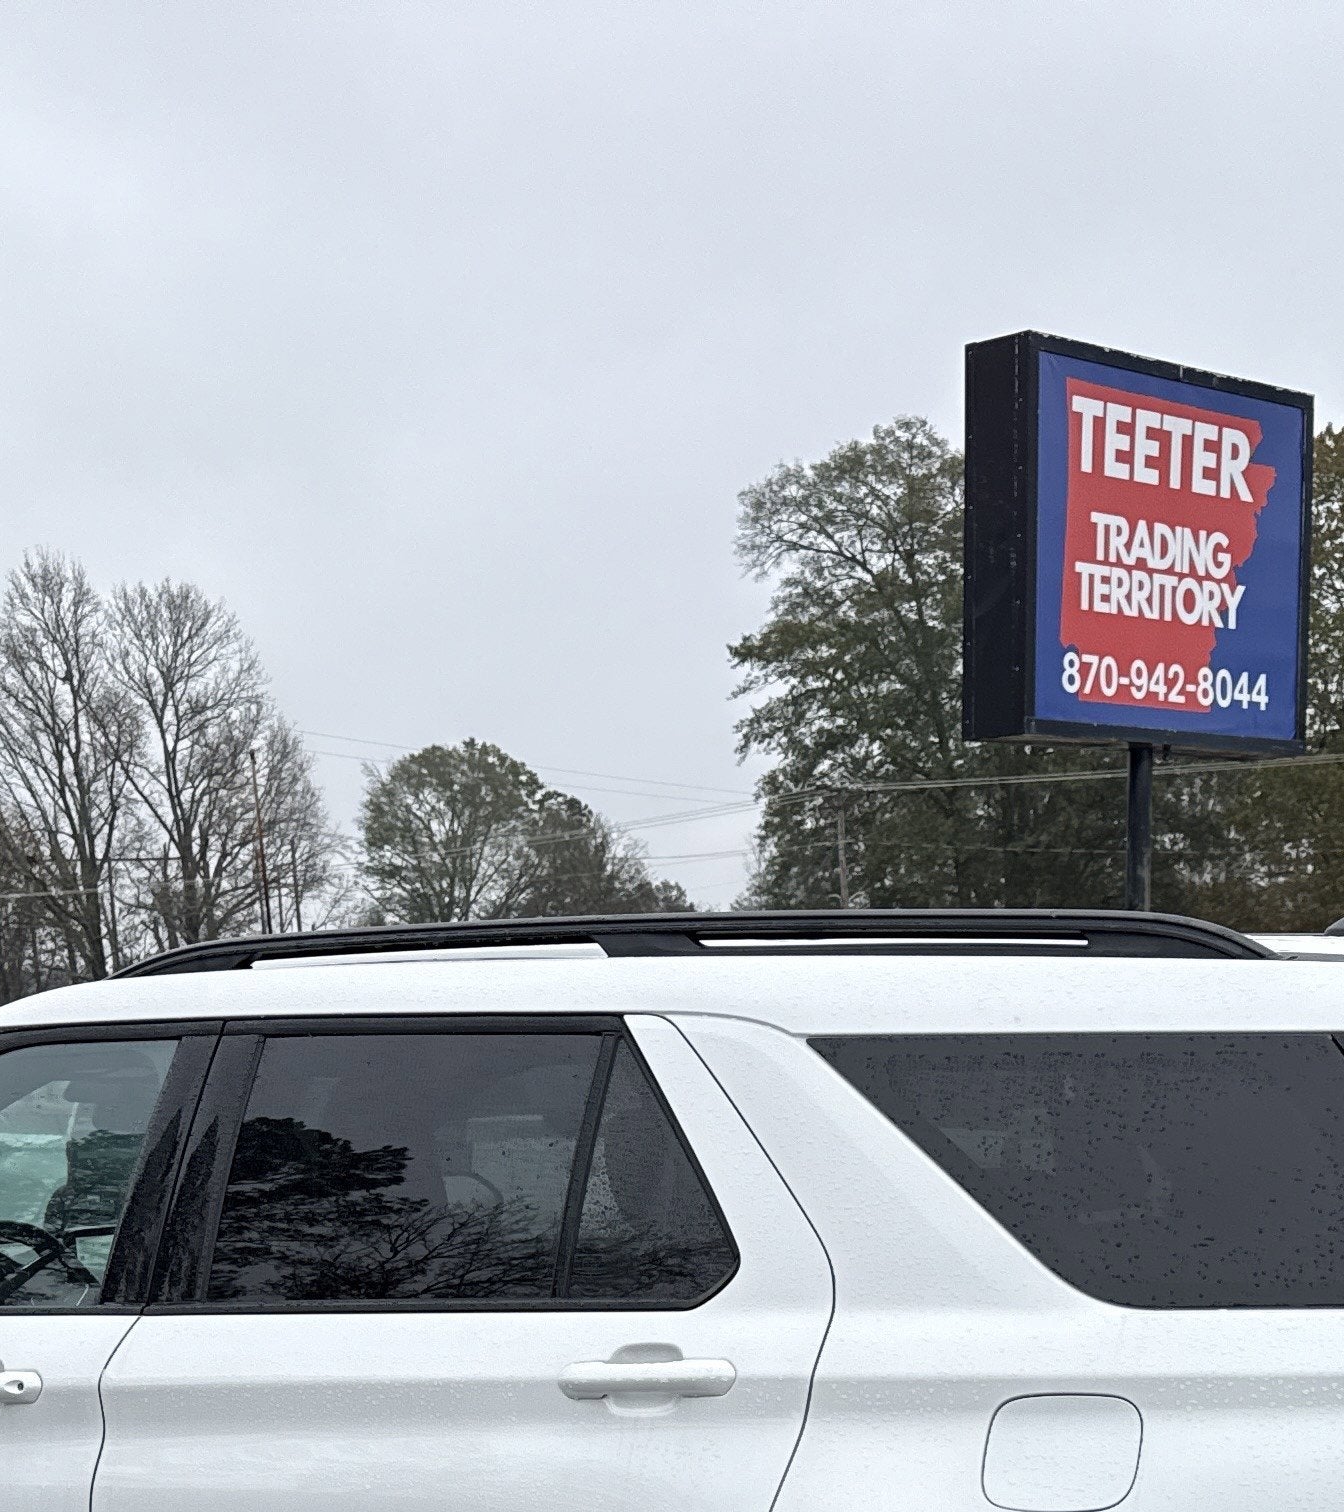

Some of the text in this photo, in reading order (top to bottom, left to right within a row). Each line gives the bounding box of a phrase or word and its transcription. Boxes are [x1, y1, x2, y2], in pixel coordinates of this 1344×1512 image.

[1072, 395, 1254, 502] TEETER
[1090, 512, 1231, 579] TRADING
[1075, 561, 1246, 630] TERRITORY
[1061, 652, 1269, 710] 870-942-8044
